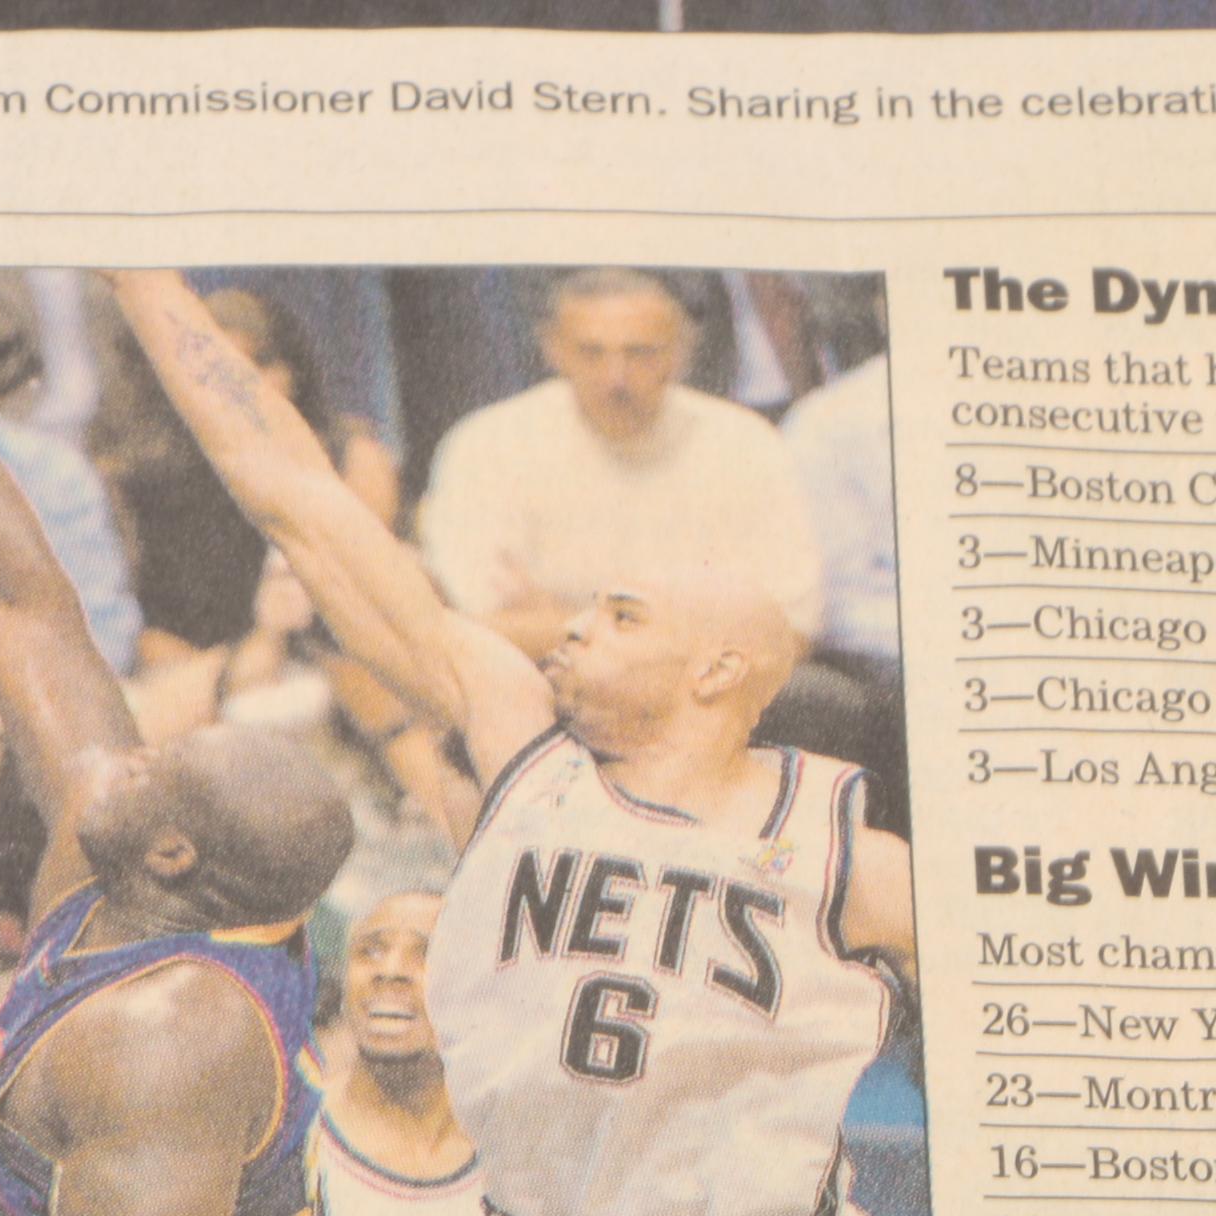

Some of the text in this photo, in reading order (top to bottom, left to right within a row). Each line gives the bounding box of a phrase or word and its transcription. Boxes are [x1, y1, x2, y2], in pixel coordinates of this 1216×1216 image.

[45, 84, 372, 115] Commissioner
[392, 82, 513, 112] David
[534, 82, 665, 115] Stern.
[688, 88, 859, 125] Sharing
[878, 95, 912, 118] in
[931, 89, 1002, 118] the
[943, 267, 1069, 312] The
[949, 347, 1090, 383] Teams
[1104, 352, 1190, 385] that
[952, 403, 1202, 433] consecutive
[972, 846, 1092, 907] Big
[496, 848, 786, 1022] NETS
[977, 933, 1083, 966] Most
[560, 970, 658, 1084] 6
